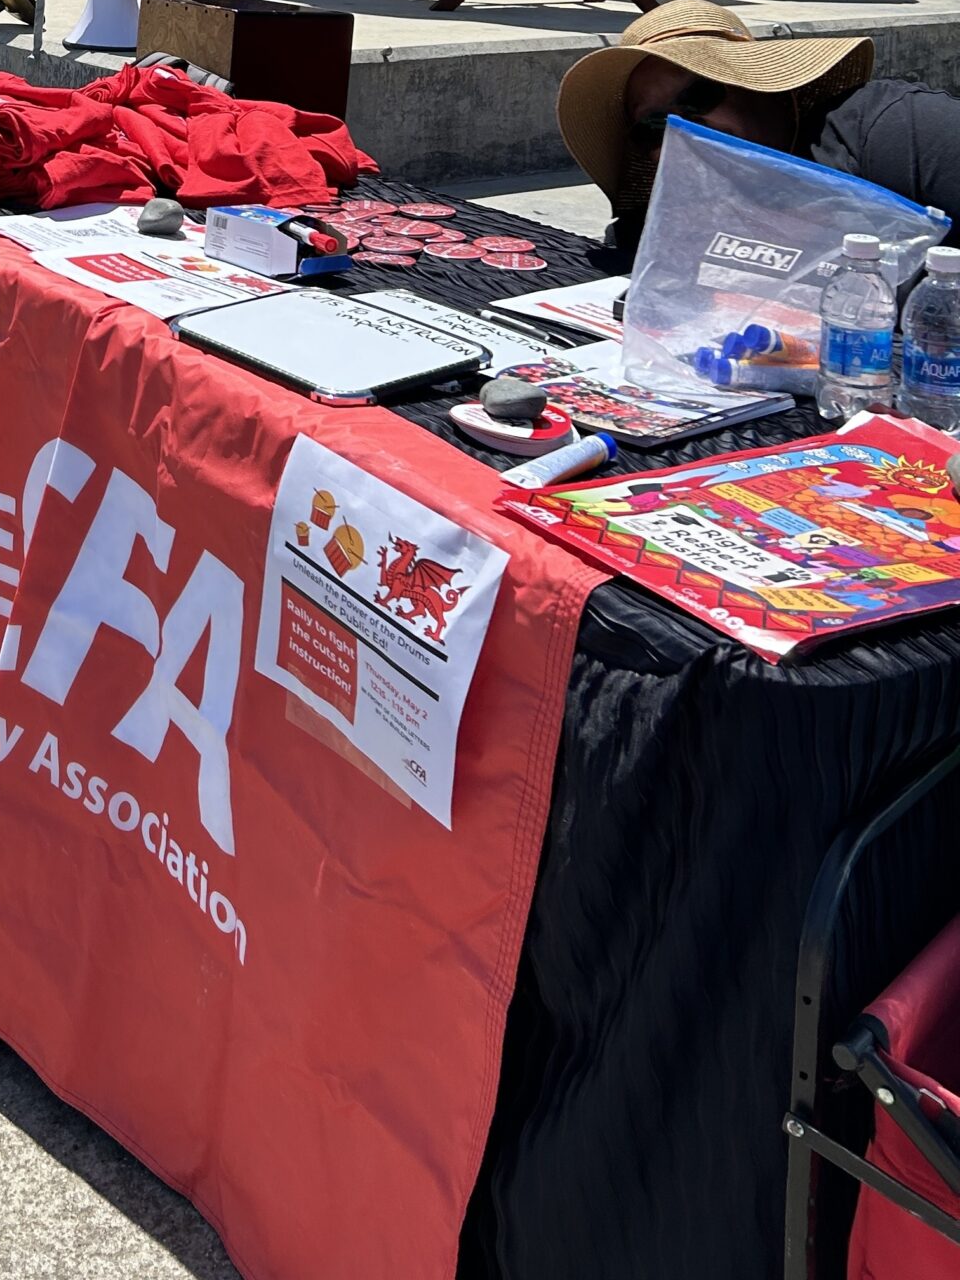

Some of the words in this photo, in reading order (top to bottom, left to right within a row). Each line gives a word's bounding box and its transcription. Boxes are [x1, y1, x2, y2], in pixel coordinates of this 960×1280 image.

[651, 534, 729, 572] Justice
[669, 528, 760, 570] Respect
[700, 528, 771, 563] Rights
[287, 598, 313, 627] Rally
[315, 620, 328, 637] to
[329, 630, 356, 660] fight
[293, 558, 324, 588] Unleash
[325, 582, 339, 599] the
[341, 594, 368, 619] Power
[369, 617, 379, 628] of
[380, 623, 396, 640] the
[397, 636, 431, 666] Drums
[324, 595, 337, 612] for
[340, 607, 370, 637] Public
[373, 631, 389, 652] Ed!
[288, 636, 352, 696] instruction!
[291, 621, 311, 643] the
[312, 638, 337, 663] cuts
[338, 657, 350, 674] to
[365, 661, 401, 700] Thursday,
[403, 694, 420, 715] May
[406, 713, 420, 730] pm
[410, 759, 427, 782] CFA
[28, 731, 248, 967] Association
